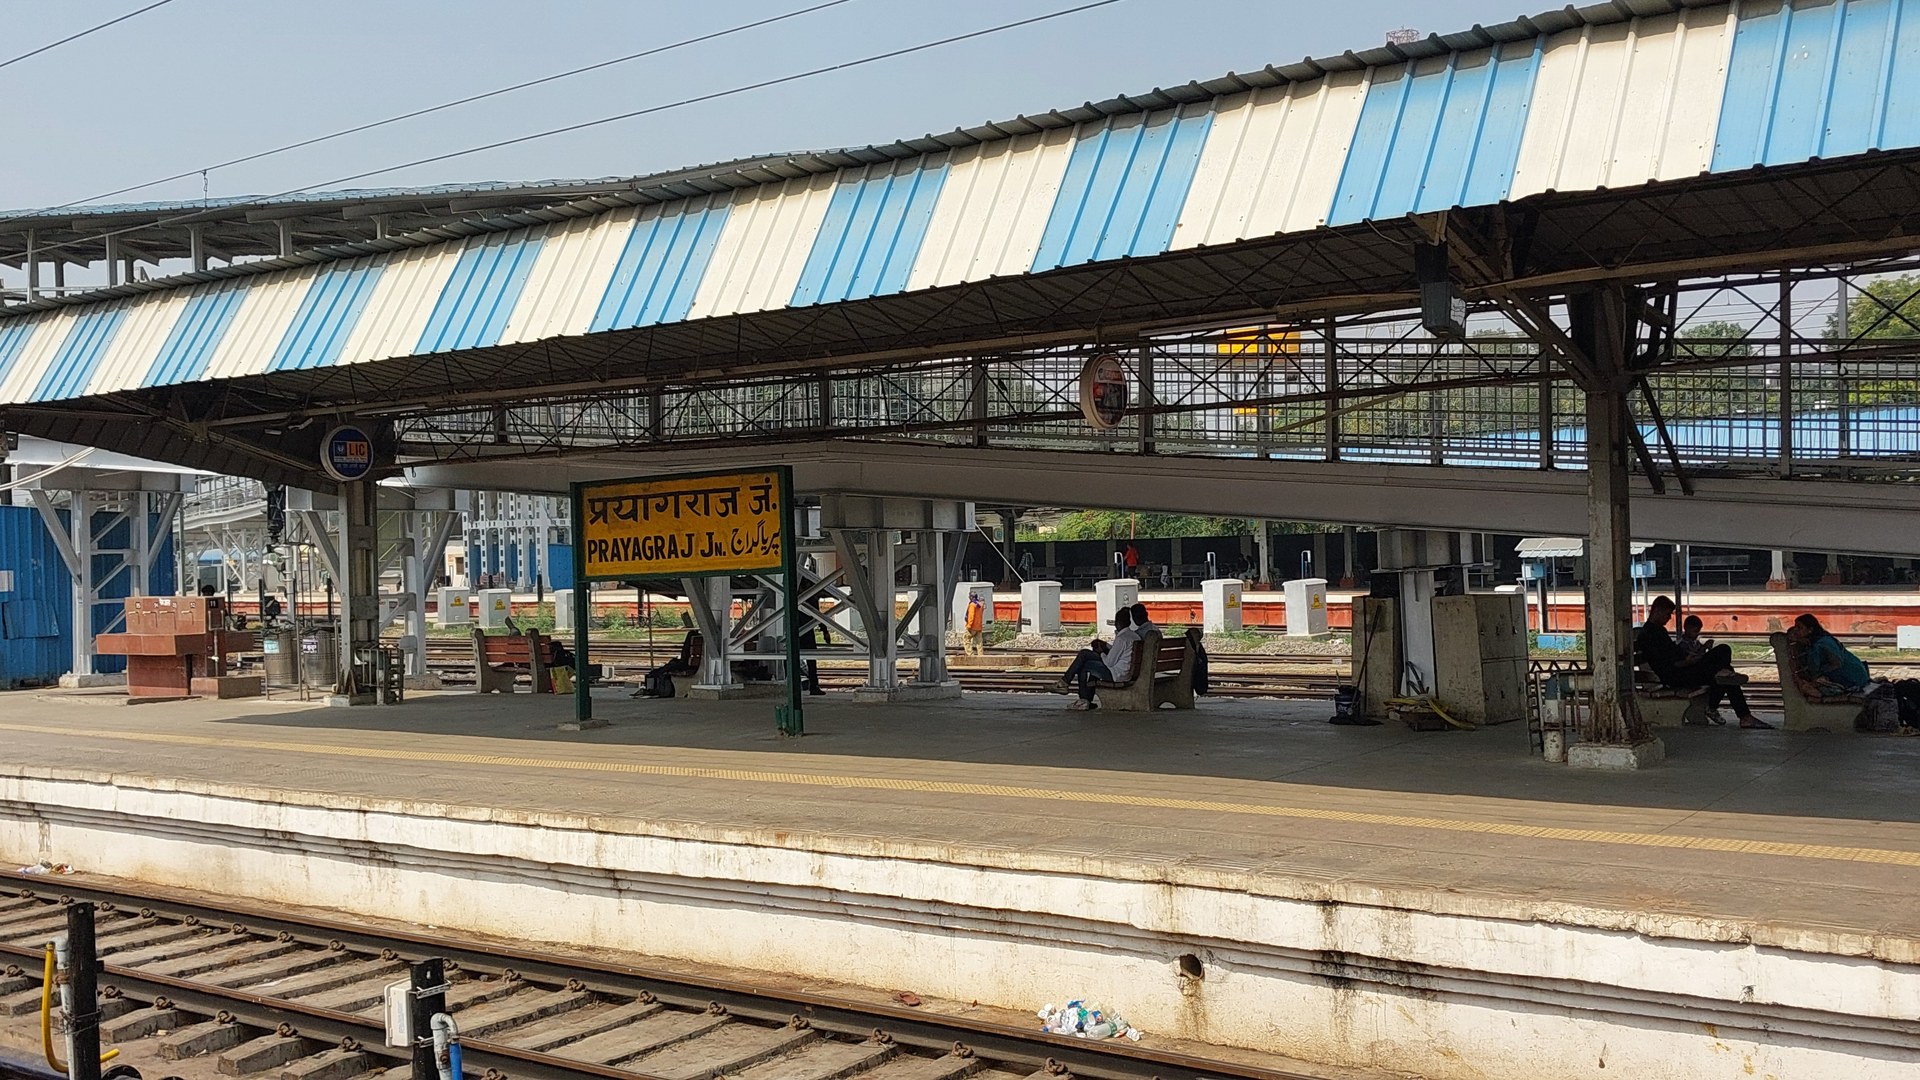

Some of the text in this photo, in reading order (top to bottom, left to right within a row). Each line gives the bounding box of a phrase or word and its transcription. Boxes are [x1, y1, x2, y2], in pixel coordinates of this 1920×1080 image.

[349, 443, 365, 456] LIC
[587, 477, 778, 525] प्रयागराज जं.
[587, 532, 695, 564] PRAYAGRAJ
